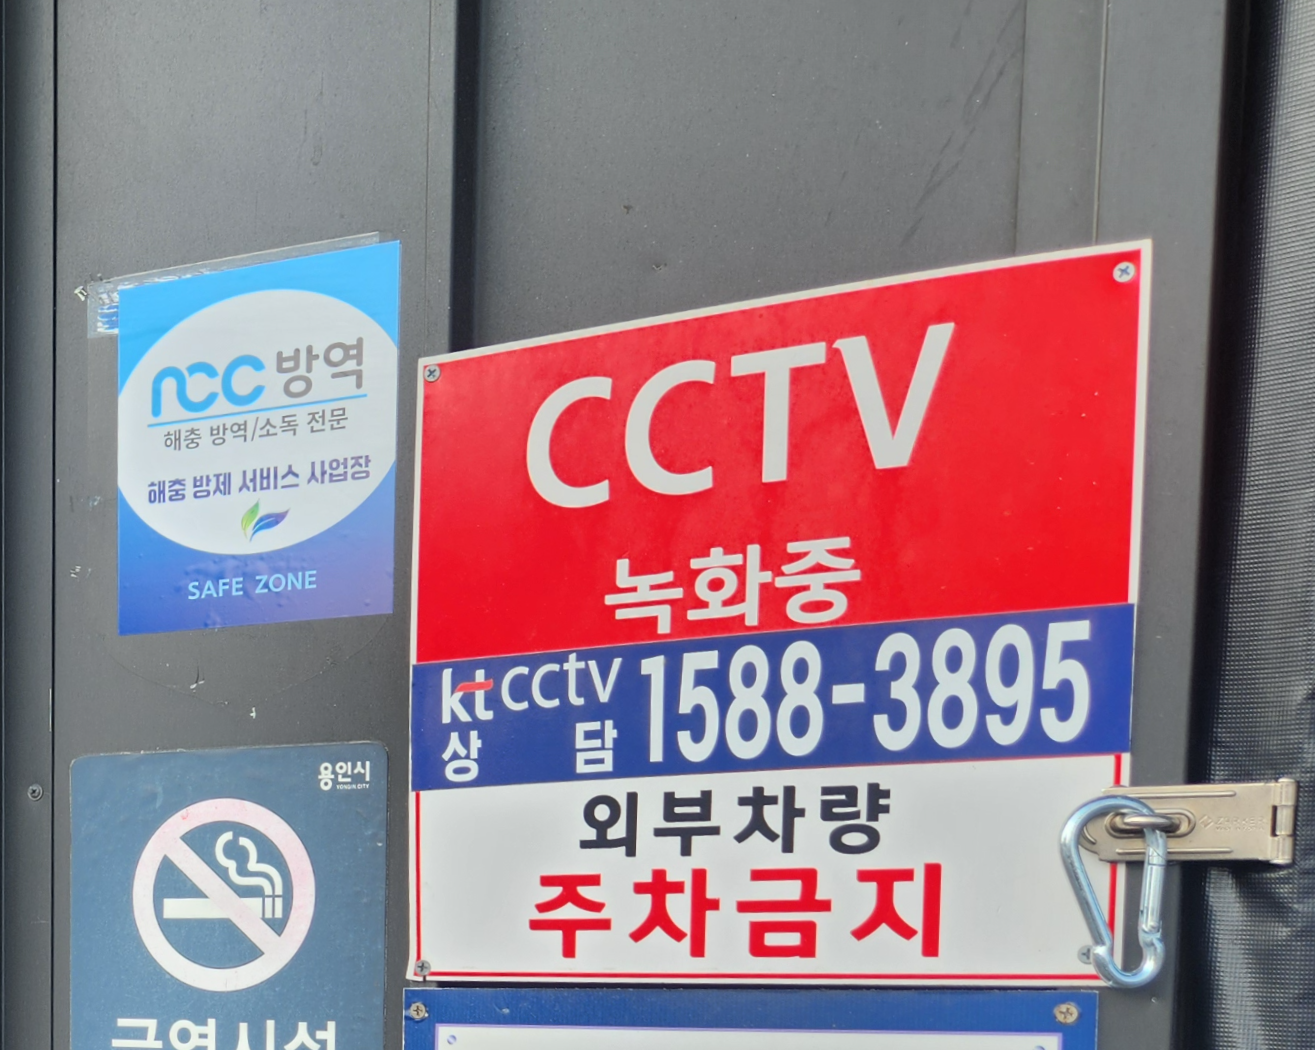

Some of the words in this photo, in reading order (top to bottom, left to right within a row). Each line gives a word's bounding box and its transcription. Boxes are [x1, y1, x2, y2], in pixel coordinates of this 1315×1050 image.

[276, 336, 364, 398] 방역
[164, 427, 202, 451] 해충
[209, 414, 299, 446] 방역/소독
[307, 407, 349, 434] 전문
[525, 322, 956, 508] CCTV
[147, 478, 186, 504] 해충
[192, 472, 232, 499] 방제
[238, 464, 300, 494] 서비스
[307, 455, 372, 485] 사업장
[188, 577, 244, 600] SAFE
[255, 570, 317, 593] ZONE
[604, 536, 862, 634] 녹화중
[442, 668, 493, 723] kt
[501, 652, 622, 711] cctv
[640, 620, 1091, 764] 1588-3895
[318, 761, 371, 791] 용인시
[579, 782, 890, 857] 외부차량
[528, 862, 943, 959] 주차금지
